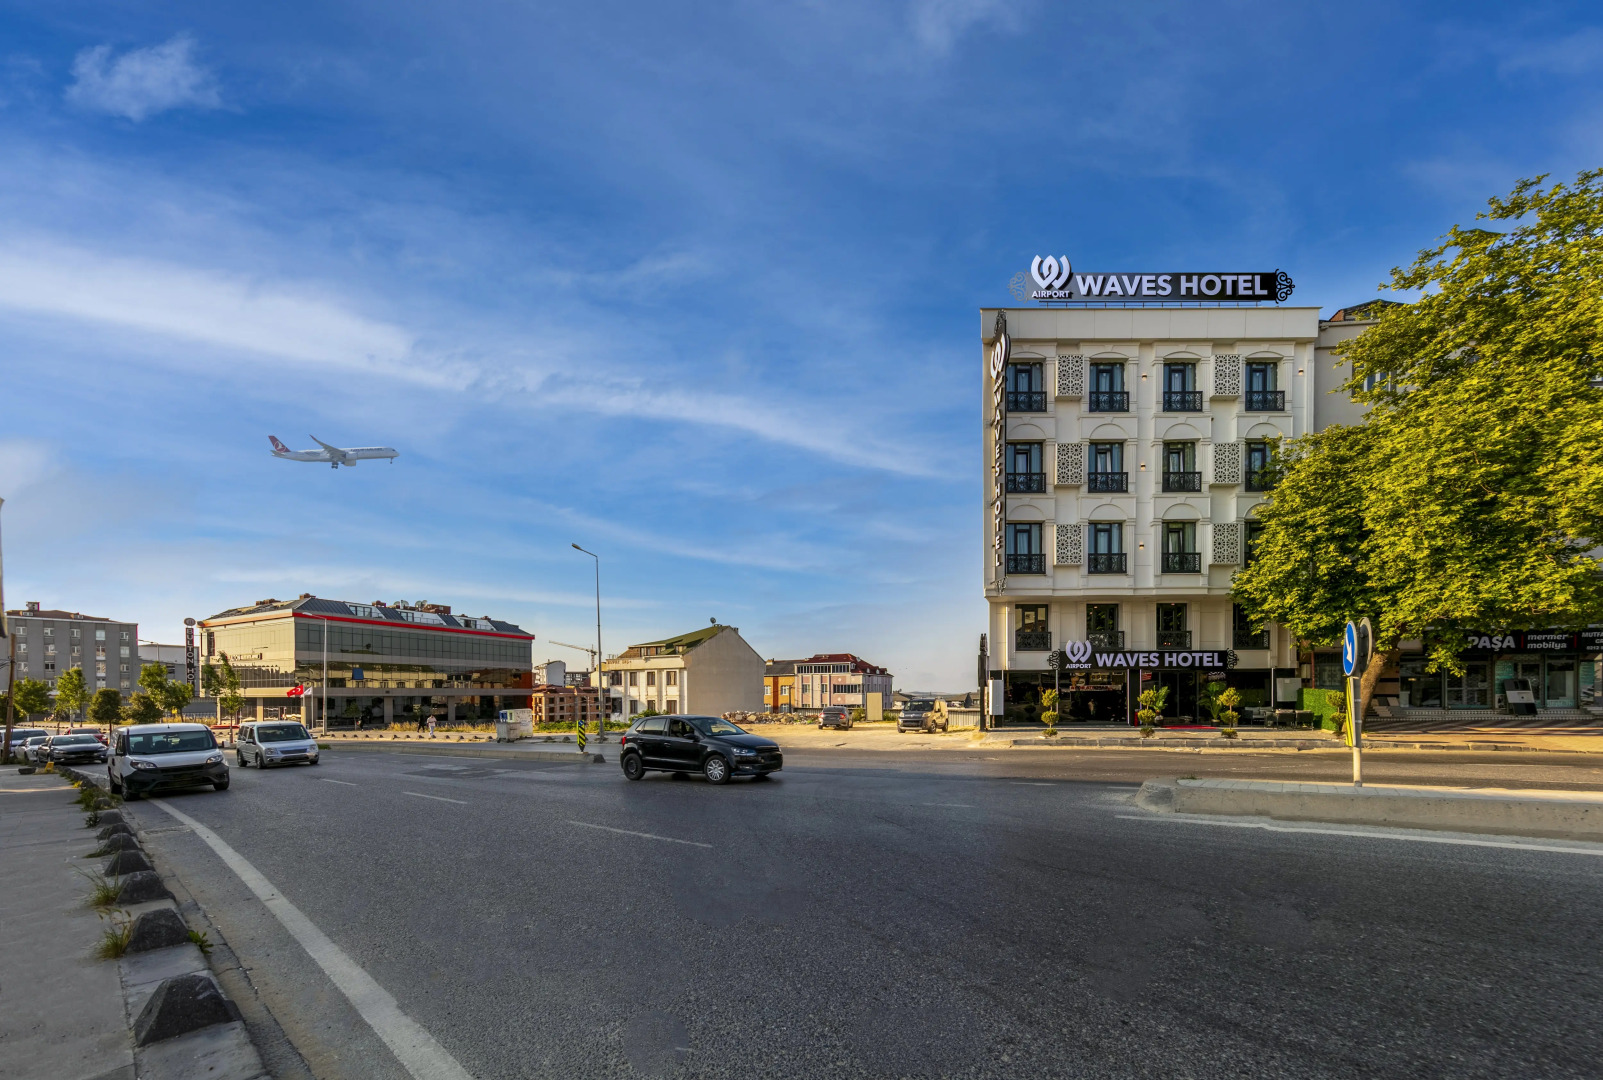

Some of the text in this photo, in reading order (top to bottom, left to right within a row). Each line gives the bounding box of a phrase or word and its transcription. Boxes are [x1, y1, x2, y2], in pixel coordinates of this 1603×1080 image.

[1031, 290, 1070, 298] AIRPORT
[1075, 274, 1268, 296] WAVES HOTEL
[993, 387, 1003, 477] WAVES
[994, 482, 1003, 567] HOTEL
[1467, 635, 1516, 652] PAŞA
[1095, 652, 1223, 667] WAVES HOTEL
